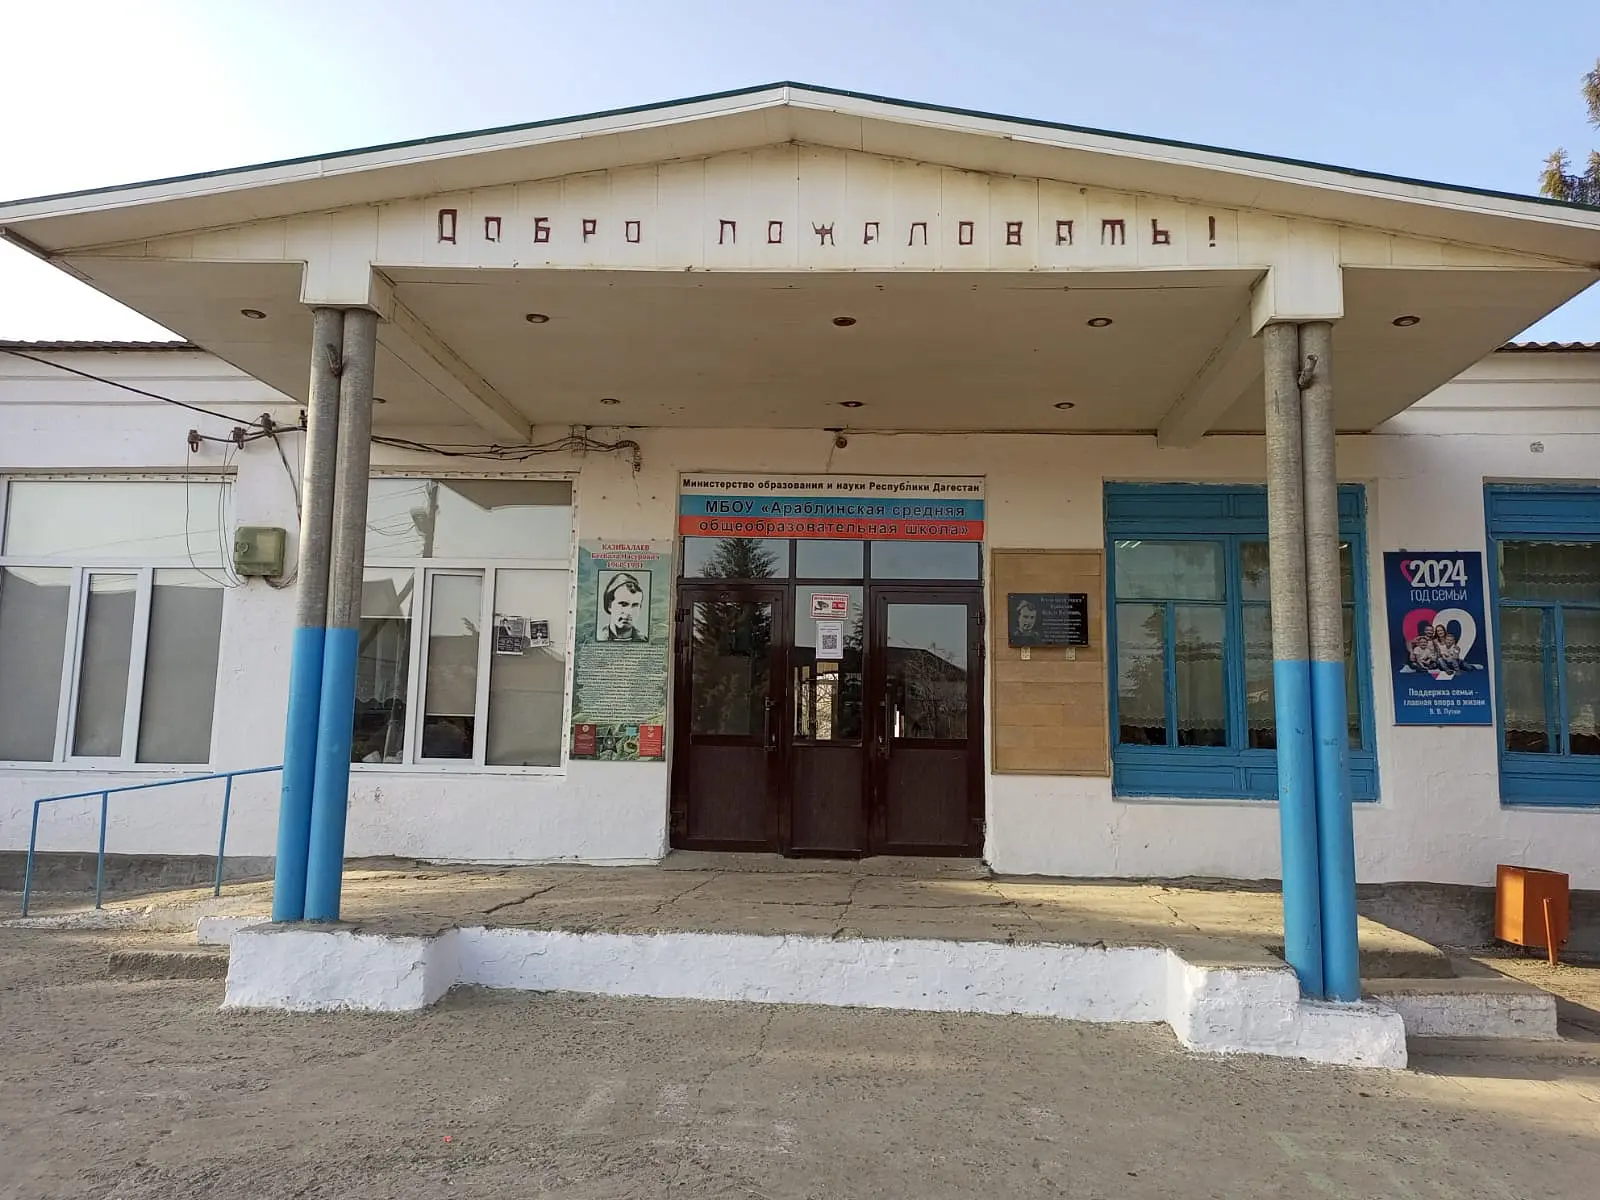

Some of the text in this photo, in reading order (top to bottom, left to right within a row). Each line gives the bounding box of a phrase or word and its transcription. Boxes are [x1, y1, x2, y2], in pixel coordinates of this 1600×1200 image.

[437, 208, 1217, 248] ДОБРО ПОЖАЛОВАТЬ!
[682, 479, 755, 492] Министерство
[757, 480, 824, 491] образования
[836, 482, 865, 493] науки
[869, 481, 930, 492] Республики
[932, 482, 980, 493] Дагестан
[705, 500, 965, 518] МБОУ «Араблинская средняя
[699, 519, 968, 535] общеобразовательная школа»
[1410, 559, 1468, 588] 2024
[1408, 688, 1451, 698] Поддержка
